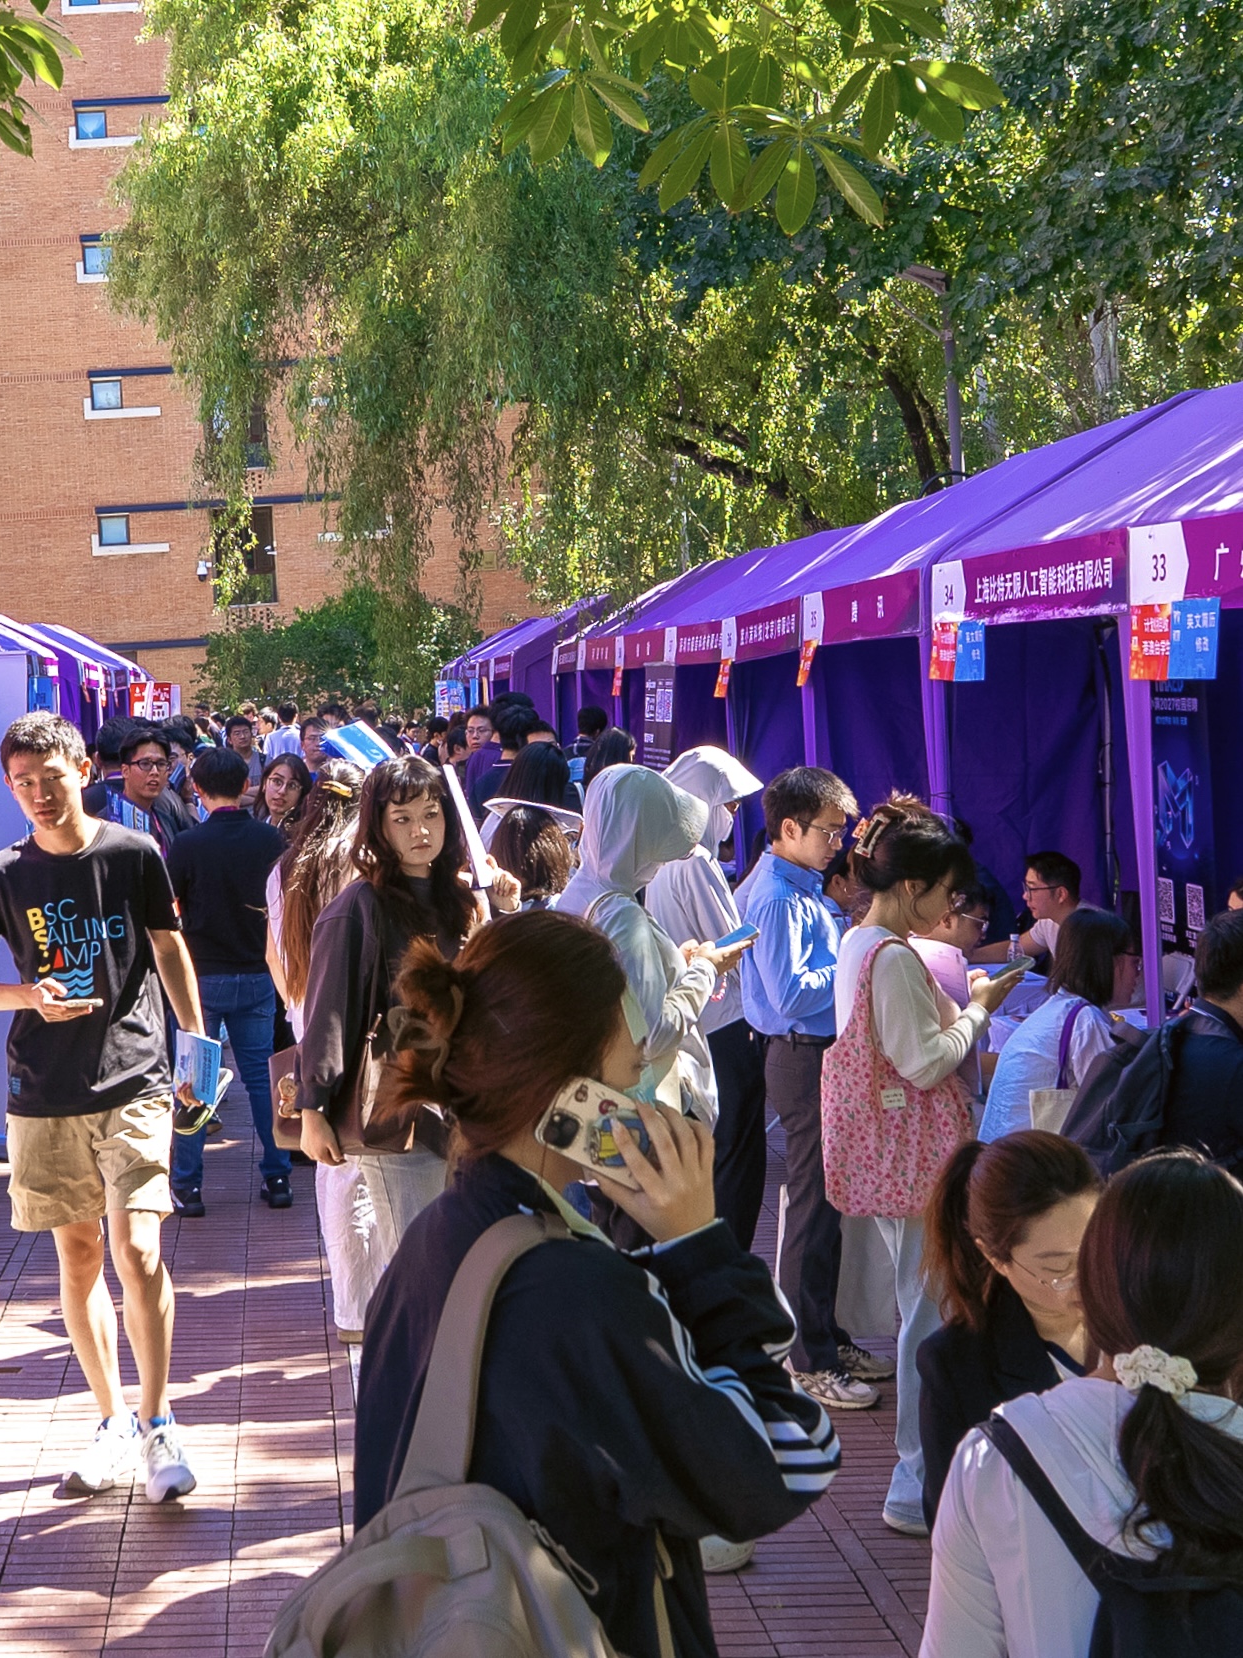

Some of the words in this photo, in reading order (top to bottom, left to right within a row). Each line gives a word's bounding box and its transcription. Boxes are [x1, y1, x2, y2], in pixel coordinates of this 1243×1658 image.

[974, 556, 1113, 604] 上海比特无限人工智能科技有限公司
[1151, 553, 1167, 582] 33
[943, 584, 955, 606] 34
[810, 610, 818, 628] 35
[1186, 611, 1216, 629] 英文简历
[33, 915, 125, 950] SAILING
